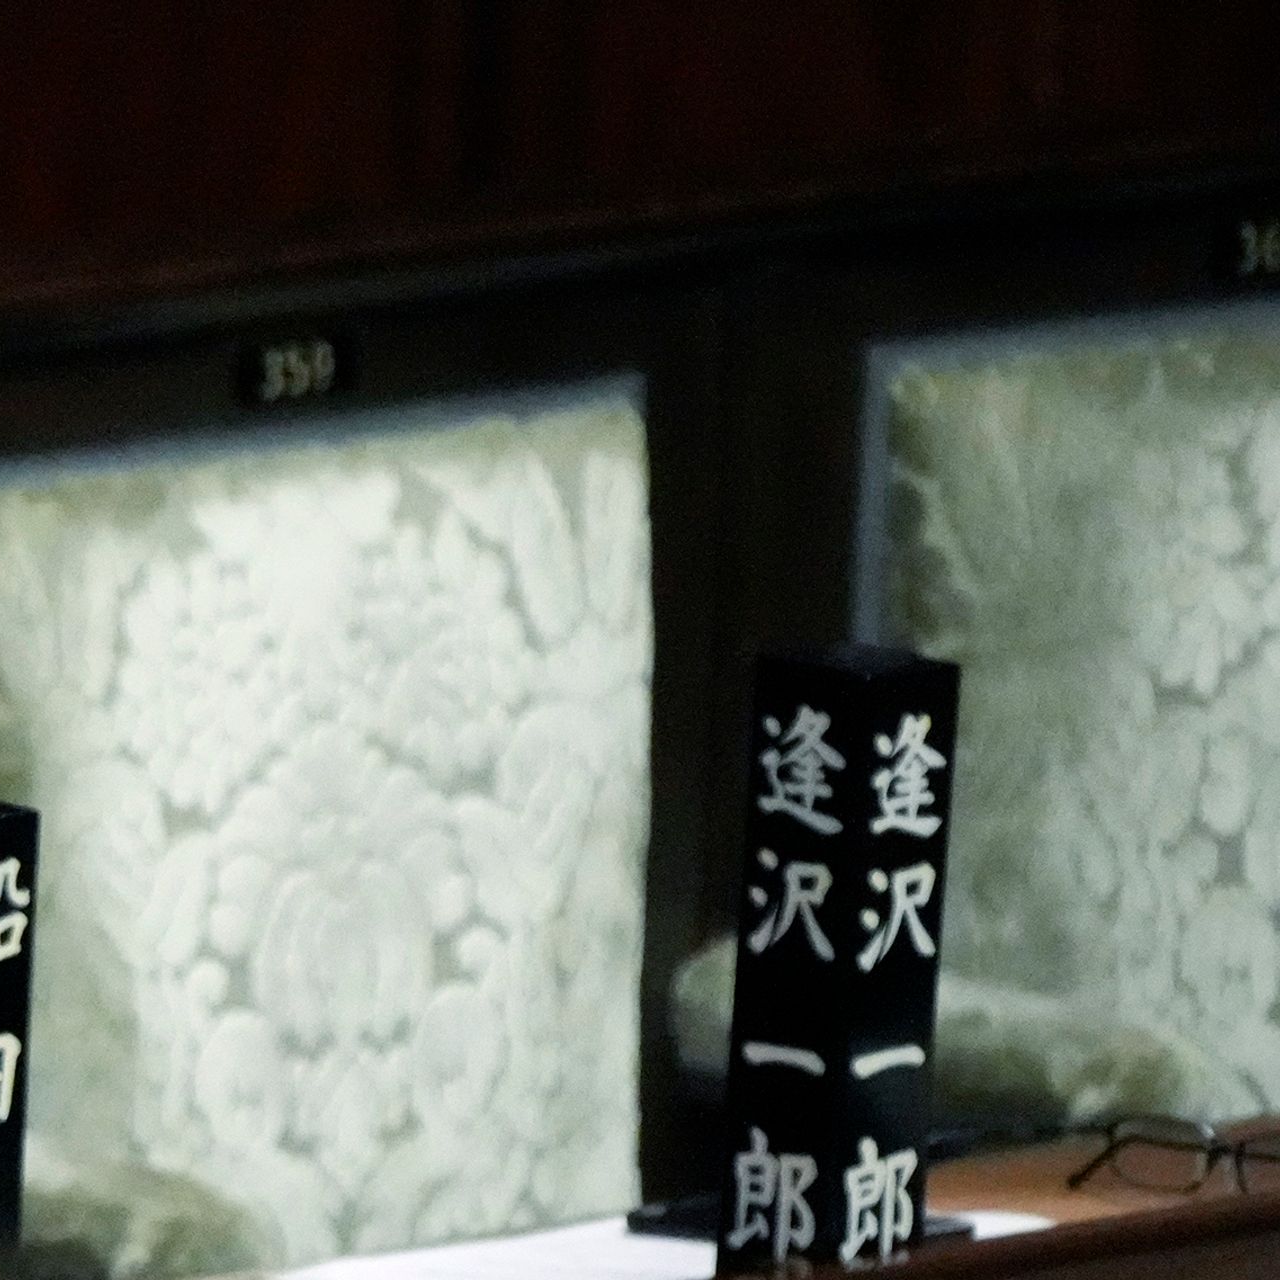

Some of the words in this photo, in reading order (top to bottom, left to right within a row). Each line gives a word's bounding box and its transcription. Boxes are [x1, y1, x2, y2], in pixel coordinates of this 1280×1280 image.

[727, 705, 846, 1264] 逢沢一郎
[840, 713, 947, 1264] 逢沢一郎
